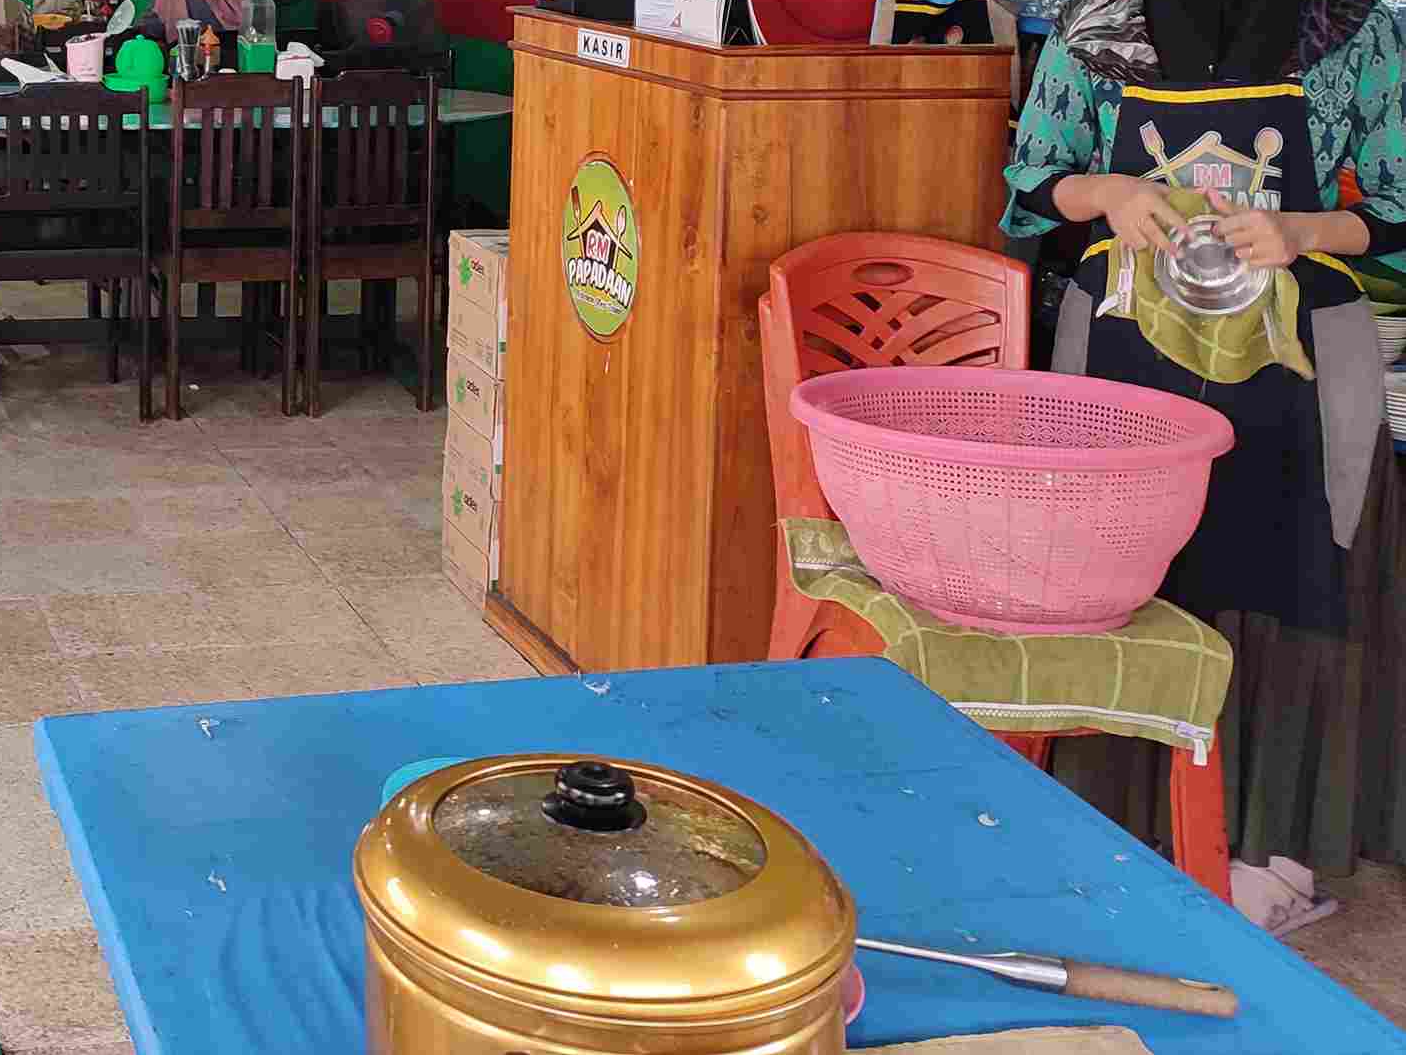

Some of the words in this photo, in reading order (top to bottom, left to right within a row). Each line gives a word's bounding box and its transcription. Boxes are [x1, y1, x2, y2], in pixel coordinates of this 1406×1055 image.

[583, 34, 624, 60] KASIR
[585, 229, 611, 265] RM
[567, 257, 633, 308] PAPADAAN
